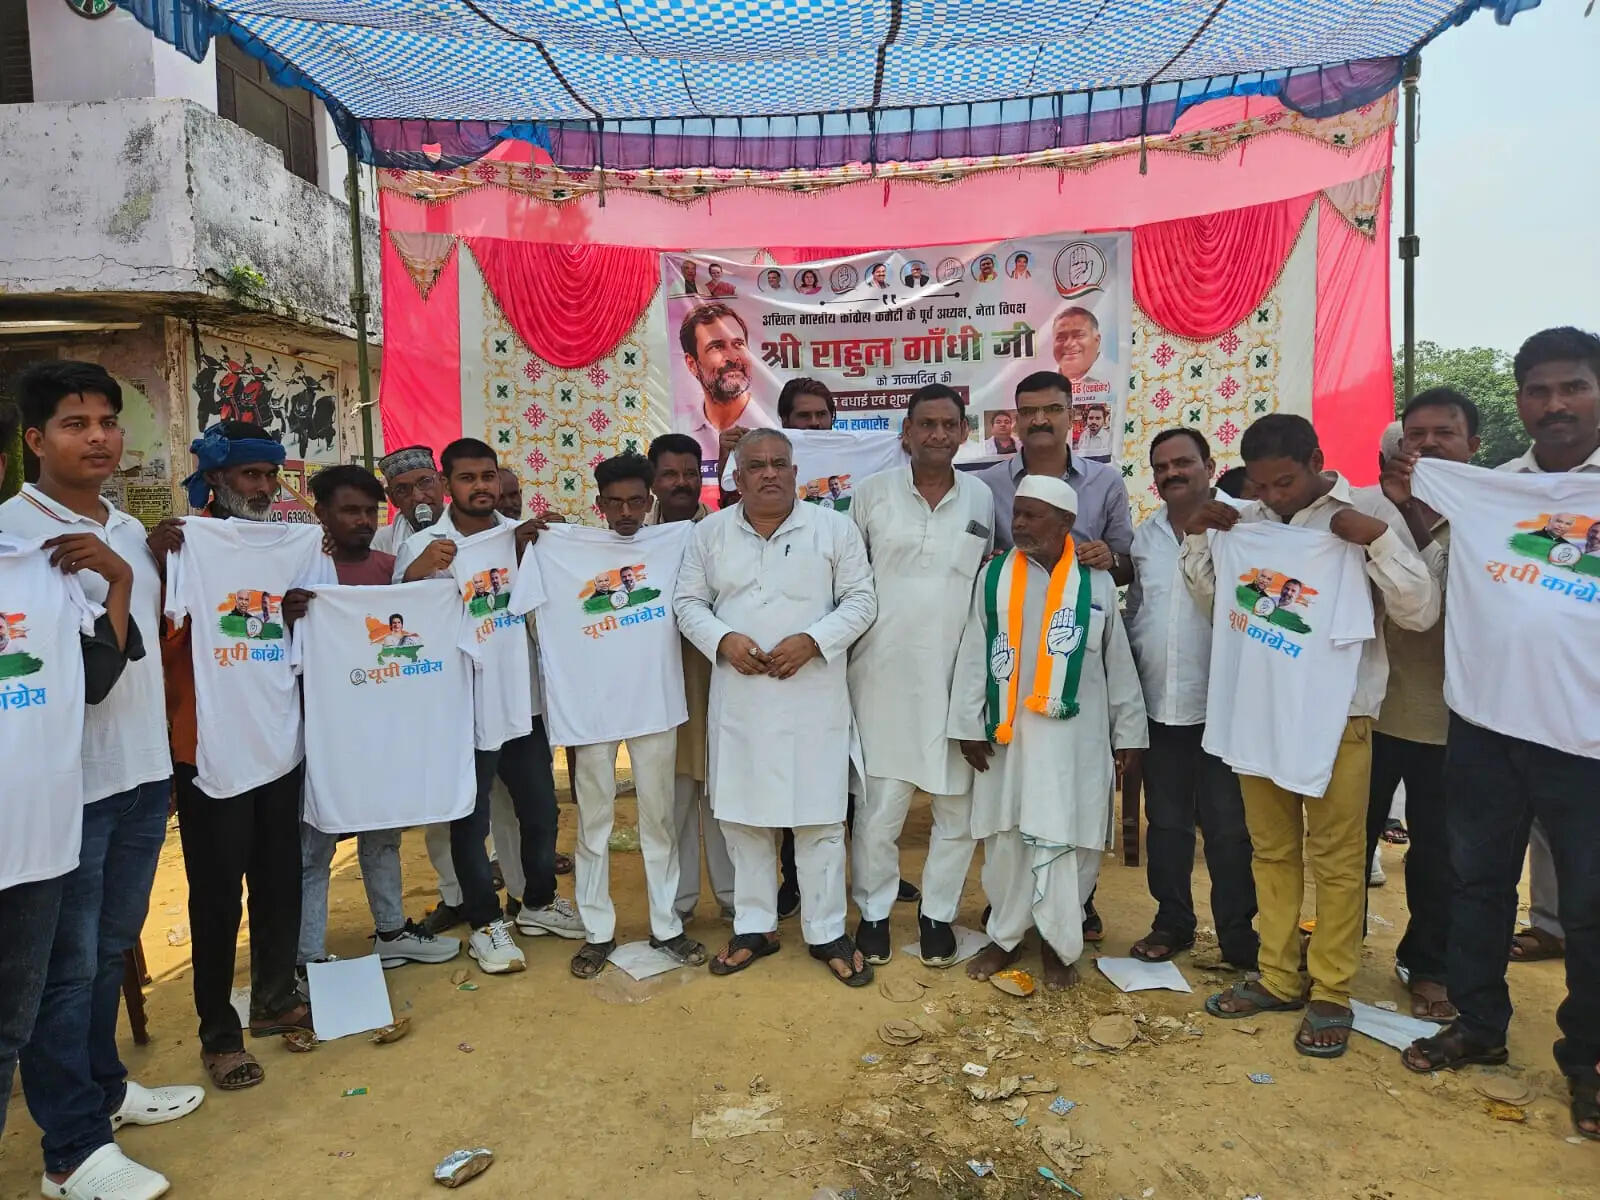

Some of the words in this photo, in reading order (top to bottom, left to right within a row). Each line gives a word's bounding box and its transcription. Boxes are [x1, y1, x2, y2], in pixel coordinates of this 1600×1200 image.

[762, 312, 797, 326] अखिल
[799, 311, 836, 325] भारतीय
[839, 308, 871, 323] कांग्रेस
[875, 306, 903, 322] कमेटी
[907, 306, 916, 320] के
[920, 305, 934, 323] पूर्व
[937, 306, 972, 320] अध्यक्ष,
[976, 303, 995, 316] नेता
[999, 301, 1027, 315] विपक्ष
[761, 332, 802, 369] श्री
[810, 337, 894, 378] राहुल
[902, 324, 983, 364] गाँधी
[991, 321, 1036, 358] जी
[876, 374, 888, 386] को
[892, 370, 937, 386] जन्मदिन
[940, 371, 952, 384] की
[840, 392, 869, 407] बधाई
[870, 392, 888, 406] एवं
[850, 414, 890, 431] समारोह
[1486, 560, 1541, 585] यूपी
[1541, 574, 1600, 603] कांग्रे
[582, 614, 617, 640] यूपी
[619, 605, 666, 626] कांग्रेस
[1229, 609, 1248, 633] यूपी
[1247, 623, 1304, 659] कांग्रेस
[213, 641, 248, 667] यूपी
[367, 662, 401, 684] यूपी
[401, 658, 443, 676] कांग्रेस
[0, 683, 46, 711] ांग्रेस
